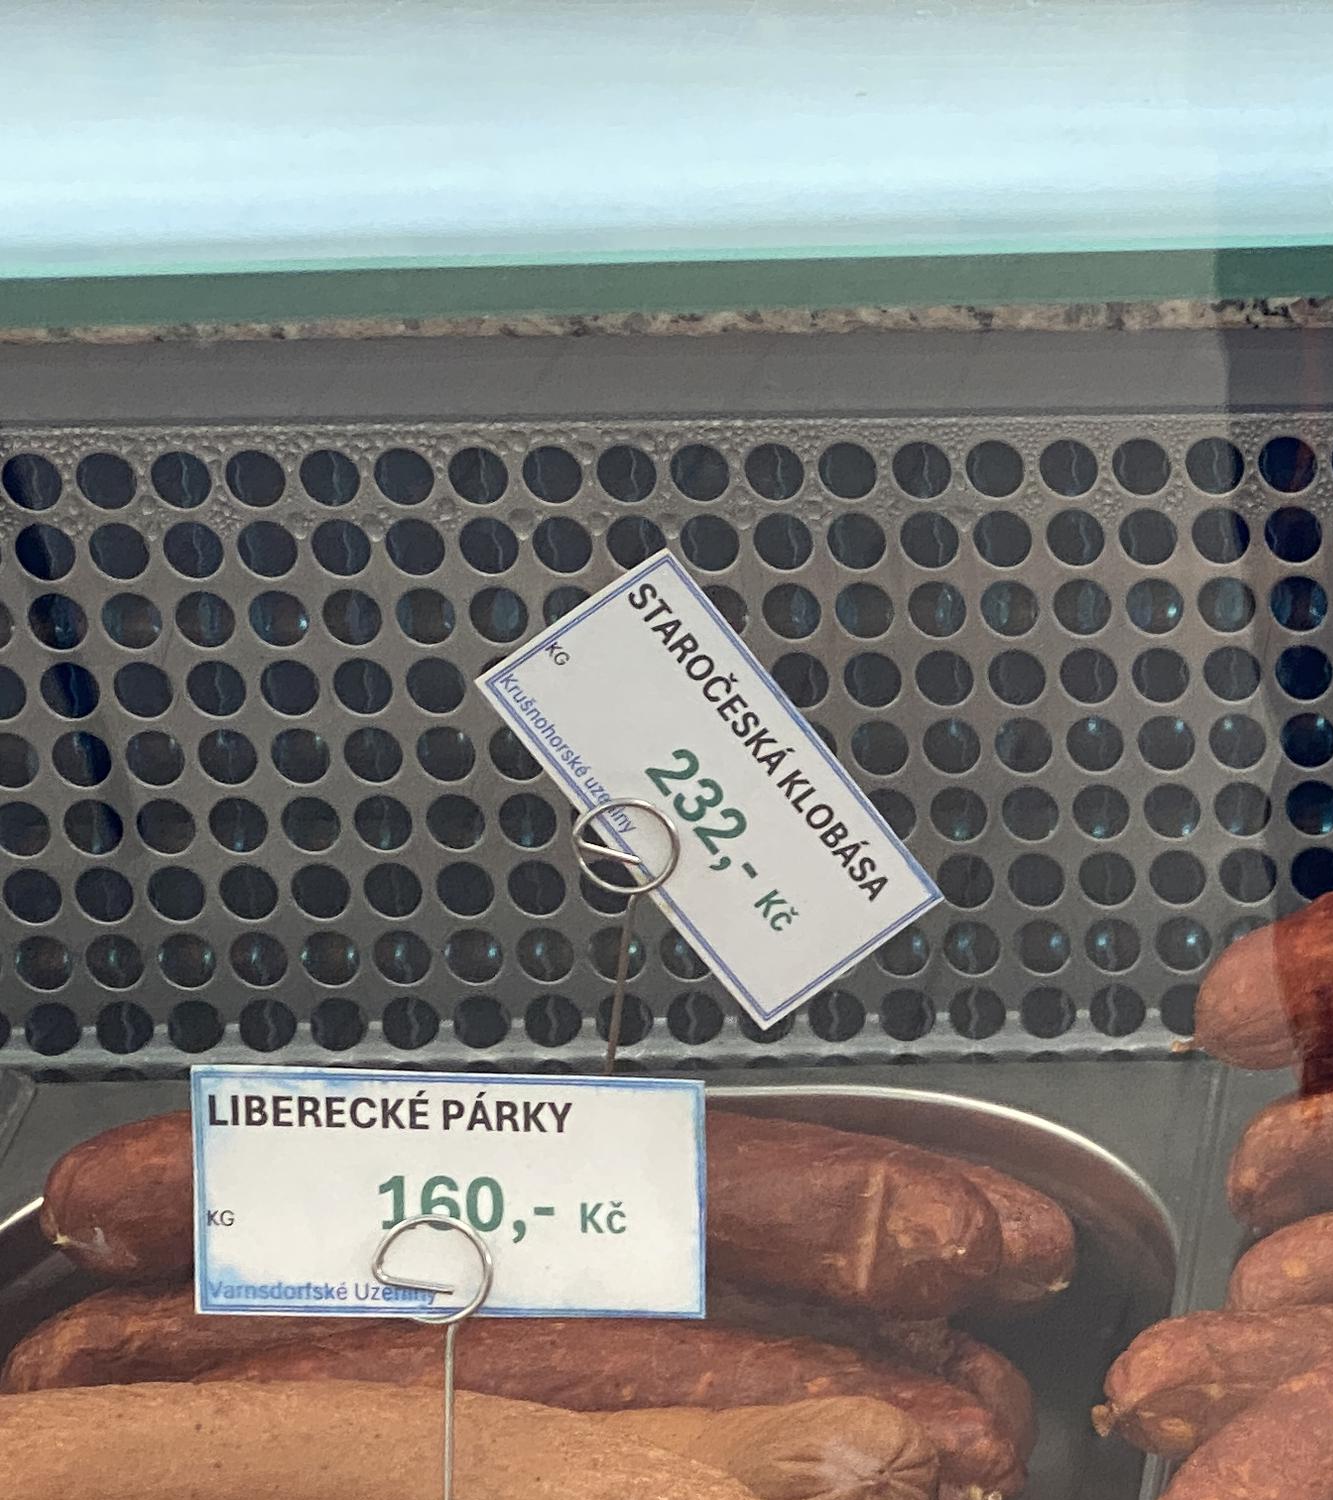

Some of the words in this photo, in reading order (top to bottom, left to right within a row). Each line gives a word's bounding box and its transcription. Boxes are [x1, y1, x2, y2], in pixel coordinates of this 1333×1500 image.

[544, 641, 571, 667] KG
[500, 673, 592, 778] Krušnohorské
[627, 581, 796, 778] STAROČESKÁ
[776, 768, 890, 903] KLOBÁSA
[644, 747, 761, 880] 232,-
[752, 888, 799, 934] Kč
[208, 1090, 430, 1131] LIBERECKÉ
[441, 1091, 573, 1134] PÁRKY
[206, 1210, 235, 1227] KG
[377, 1174, 556, 1243] 160,-
[579, 1201, 628, 1235] Kč
[208, 1280, 347, 1300] Varnsdorfské
